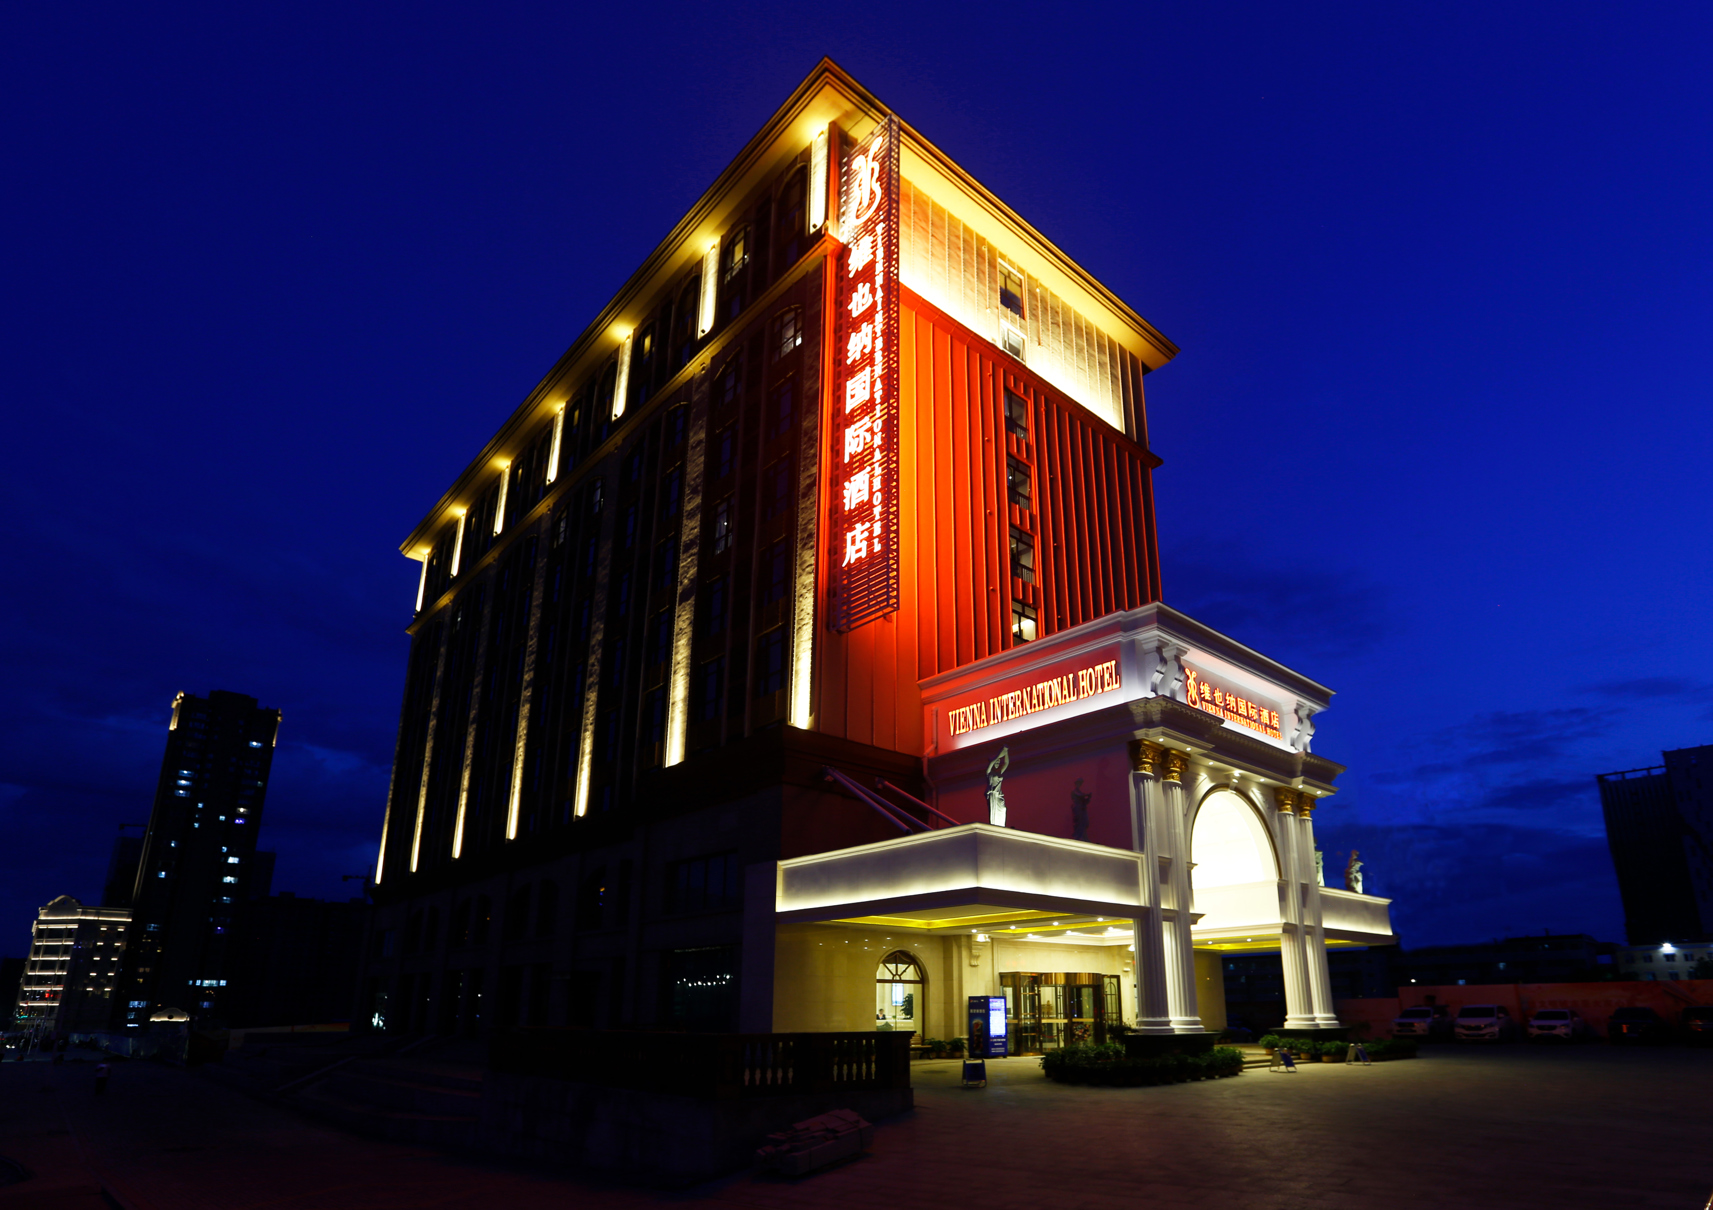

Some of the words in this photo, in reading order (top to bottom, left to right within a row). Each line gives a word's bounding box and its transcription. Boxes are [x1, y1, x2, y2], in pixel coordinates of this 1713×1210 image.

[872, 475, 882, 553] HOTEL
[948, 701, 987, 736] VIENNA
[989, 673, 1077, 724] INTERNATIONAL
[1078, 660, 1121, 699] HOTEL
[1200, 681, 1280, 729] 维也纳国际酒店
